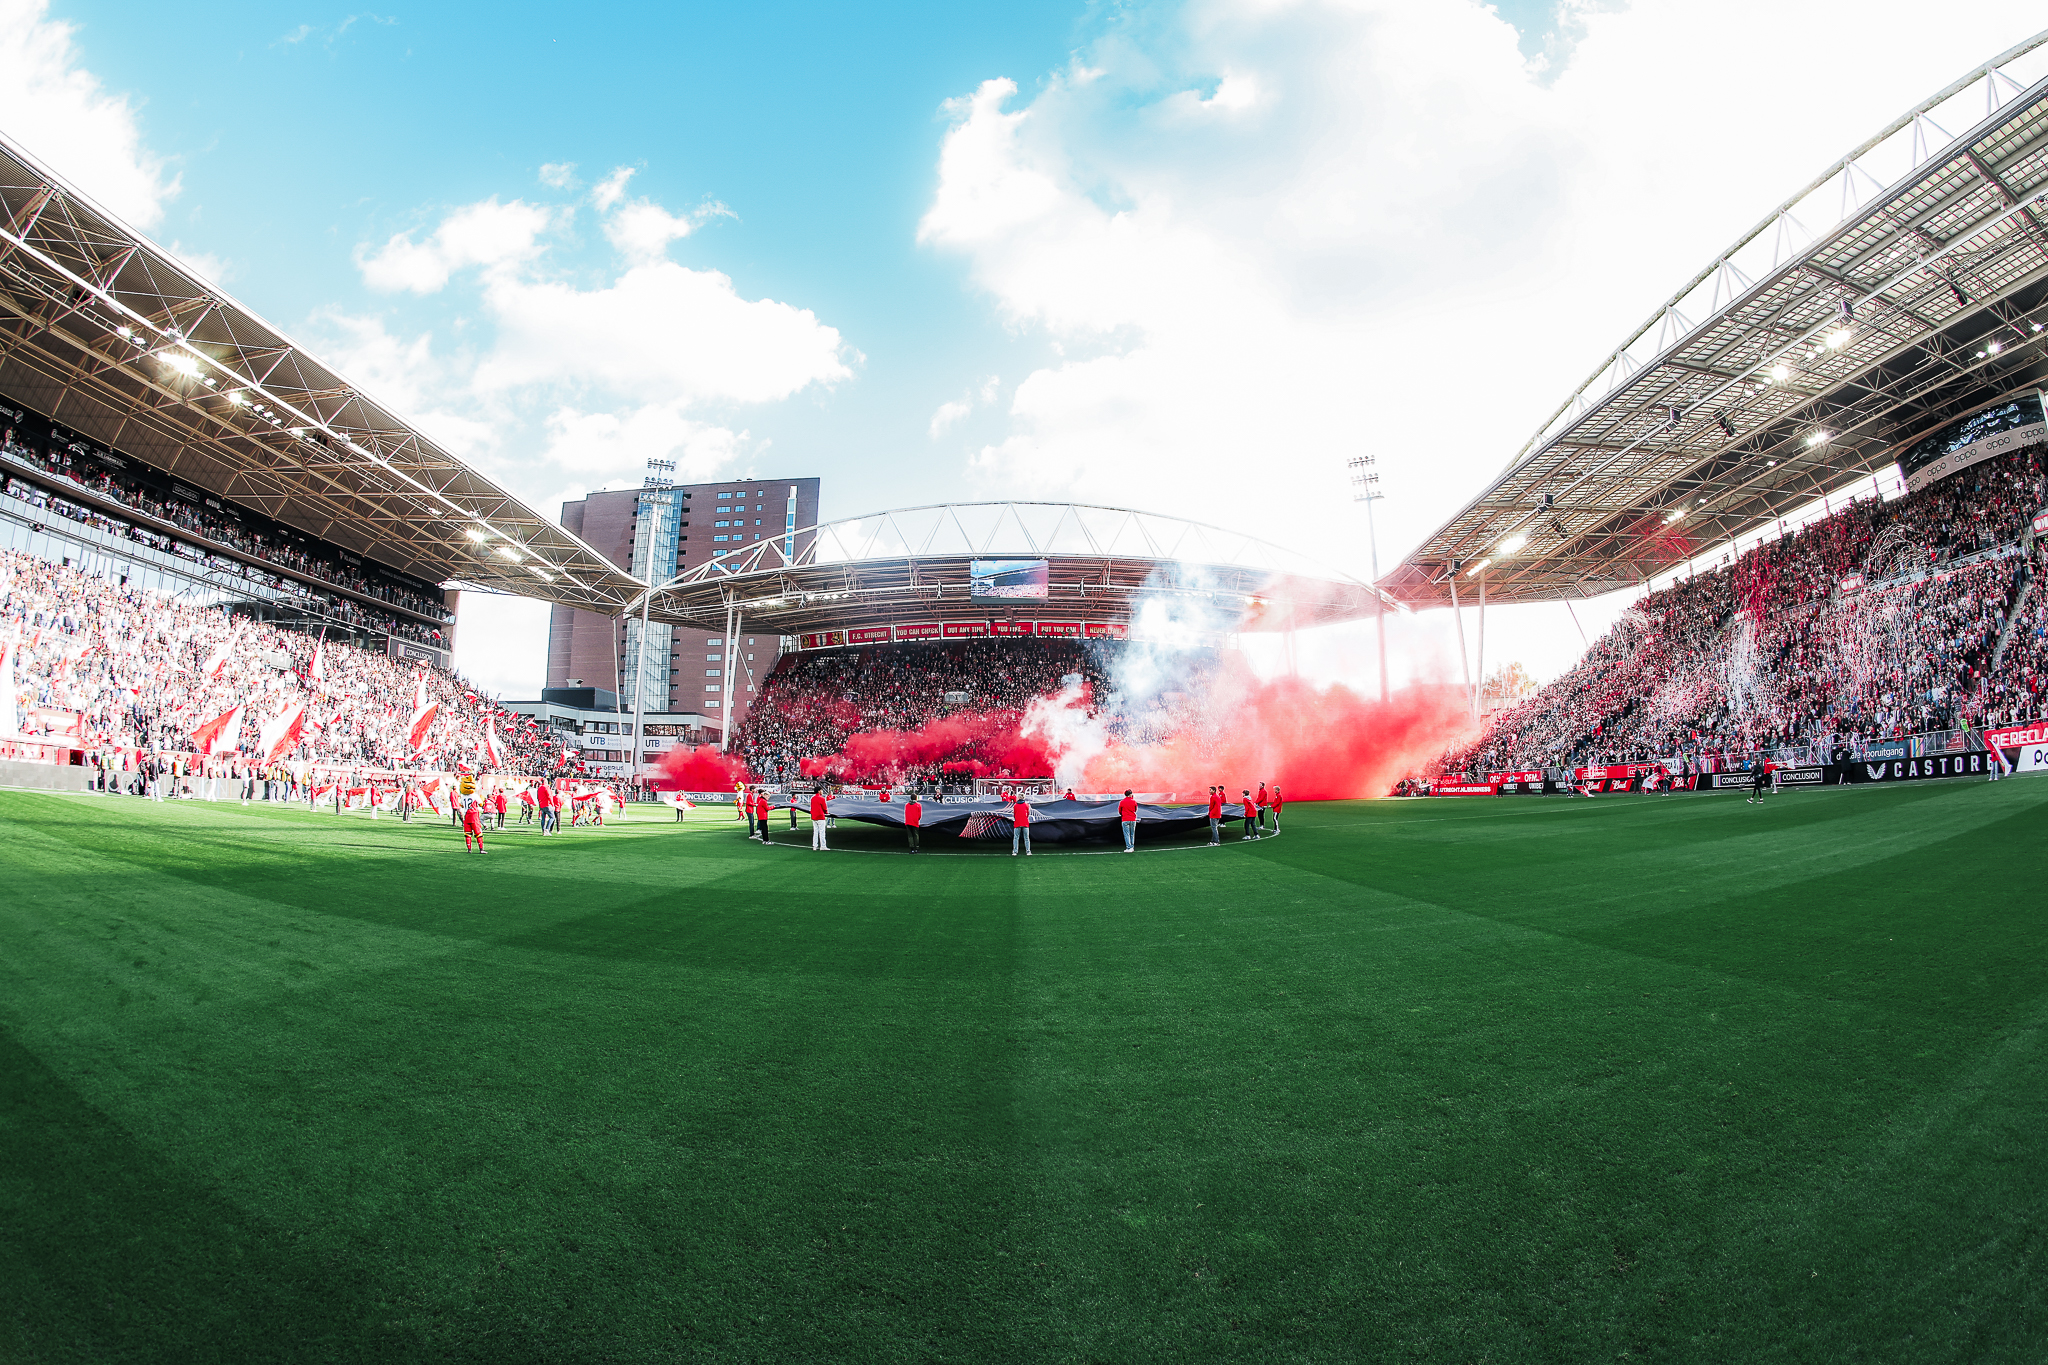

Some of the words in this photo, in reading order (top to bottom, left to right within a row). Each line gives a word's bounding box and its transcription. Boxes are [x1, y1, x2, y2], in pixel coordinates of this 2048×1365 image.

[1926, 462, 1947, 477] oppo
[1954, 448, 1977, 464] oppo
[1985, 436, 2011, 450] oppo
[2020, 427, 2045, 441] oppo
[972, 625, 984, 633] TIME
[1089, 626, 1106, 634] NEVER
[864, 630, 887, 639] UTRECHT
[406, 649, 433, 661] CONCLUSION
[590, 736, 606, 745] UTB
[645, 739, 661, 748] UTB
[1893, 753, 1994, 778] CASTORE
[1782, 771, 1820, 781] CONCLUSION
[1612, 778, 1627, 790] Bud
